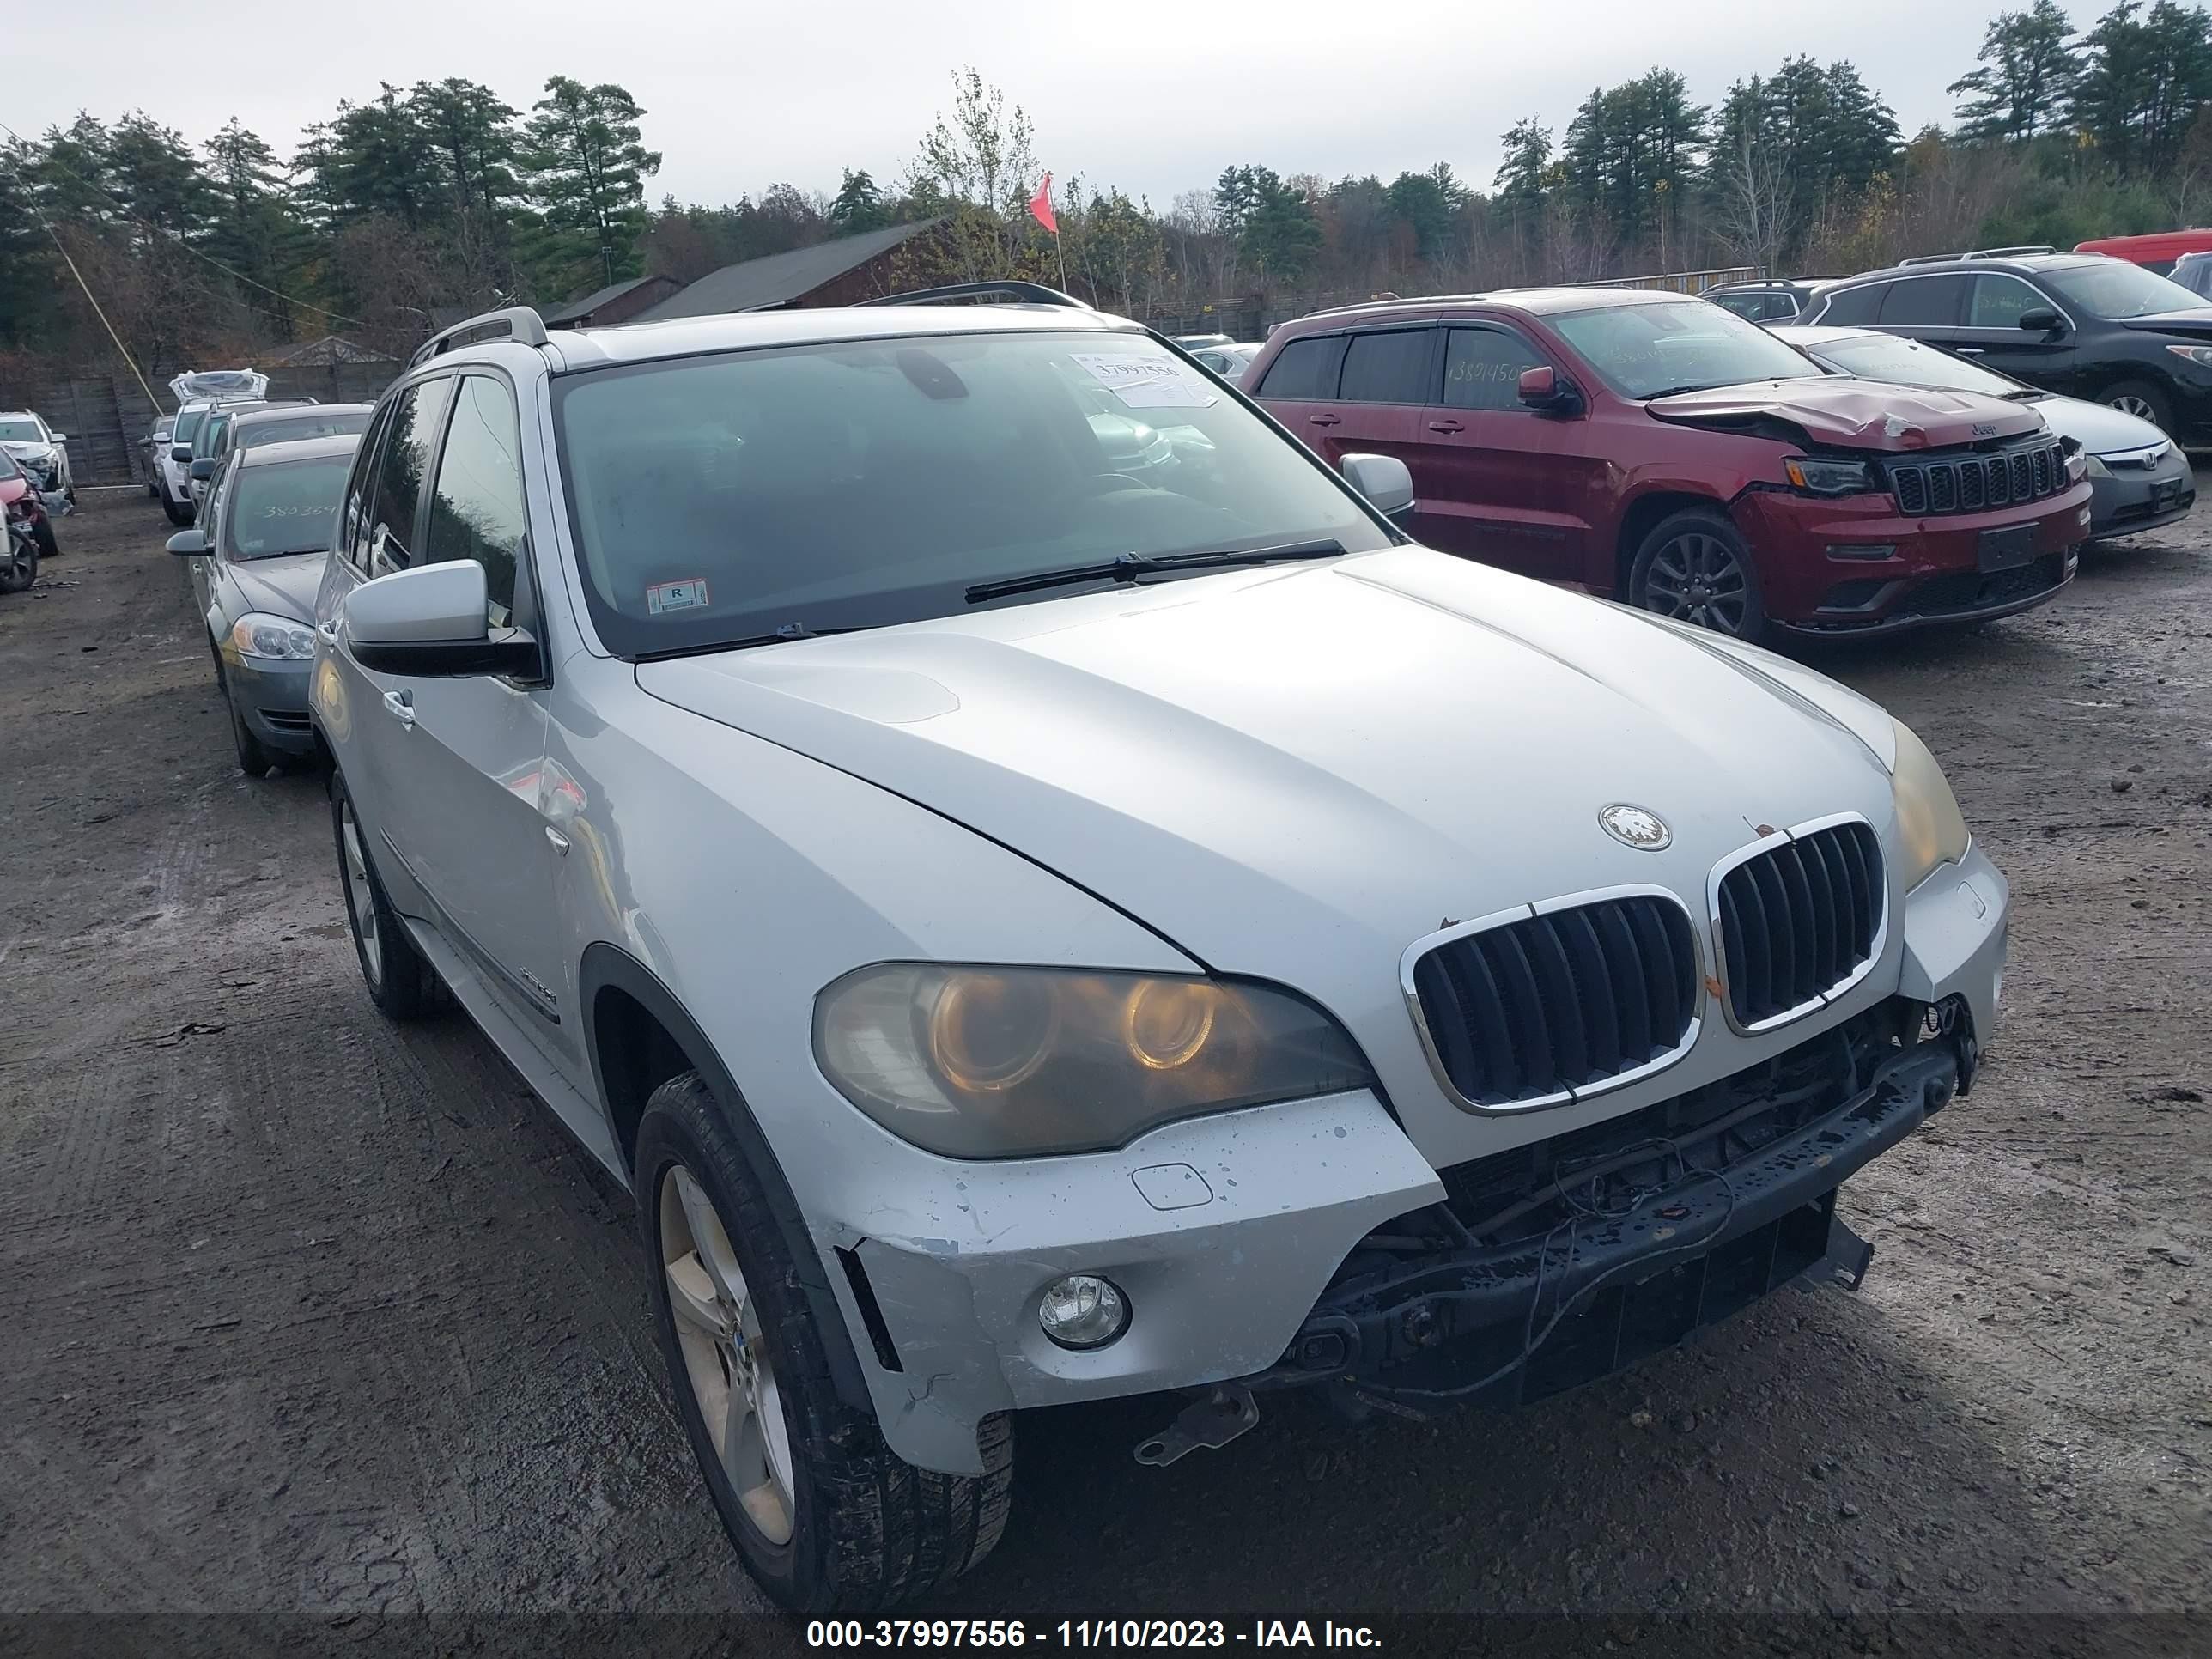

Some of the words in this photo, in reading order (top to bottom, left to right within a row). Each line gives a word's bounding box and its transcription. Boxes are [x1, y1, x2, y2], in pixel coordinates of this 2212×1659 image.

[1095, 364, 1181, 377] 37997556
[1972, 423, 1997, 436] Jeep
[672, 588, 683, 599] R
